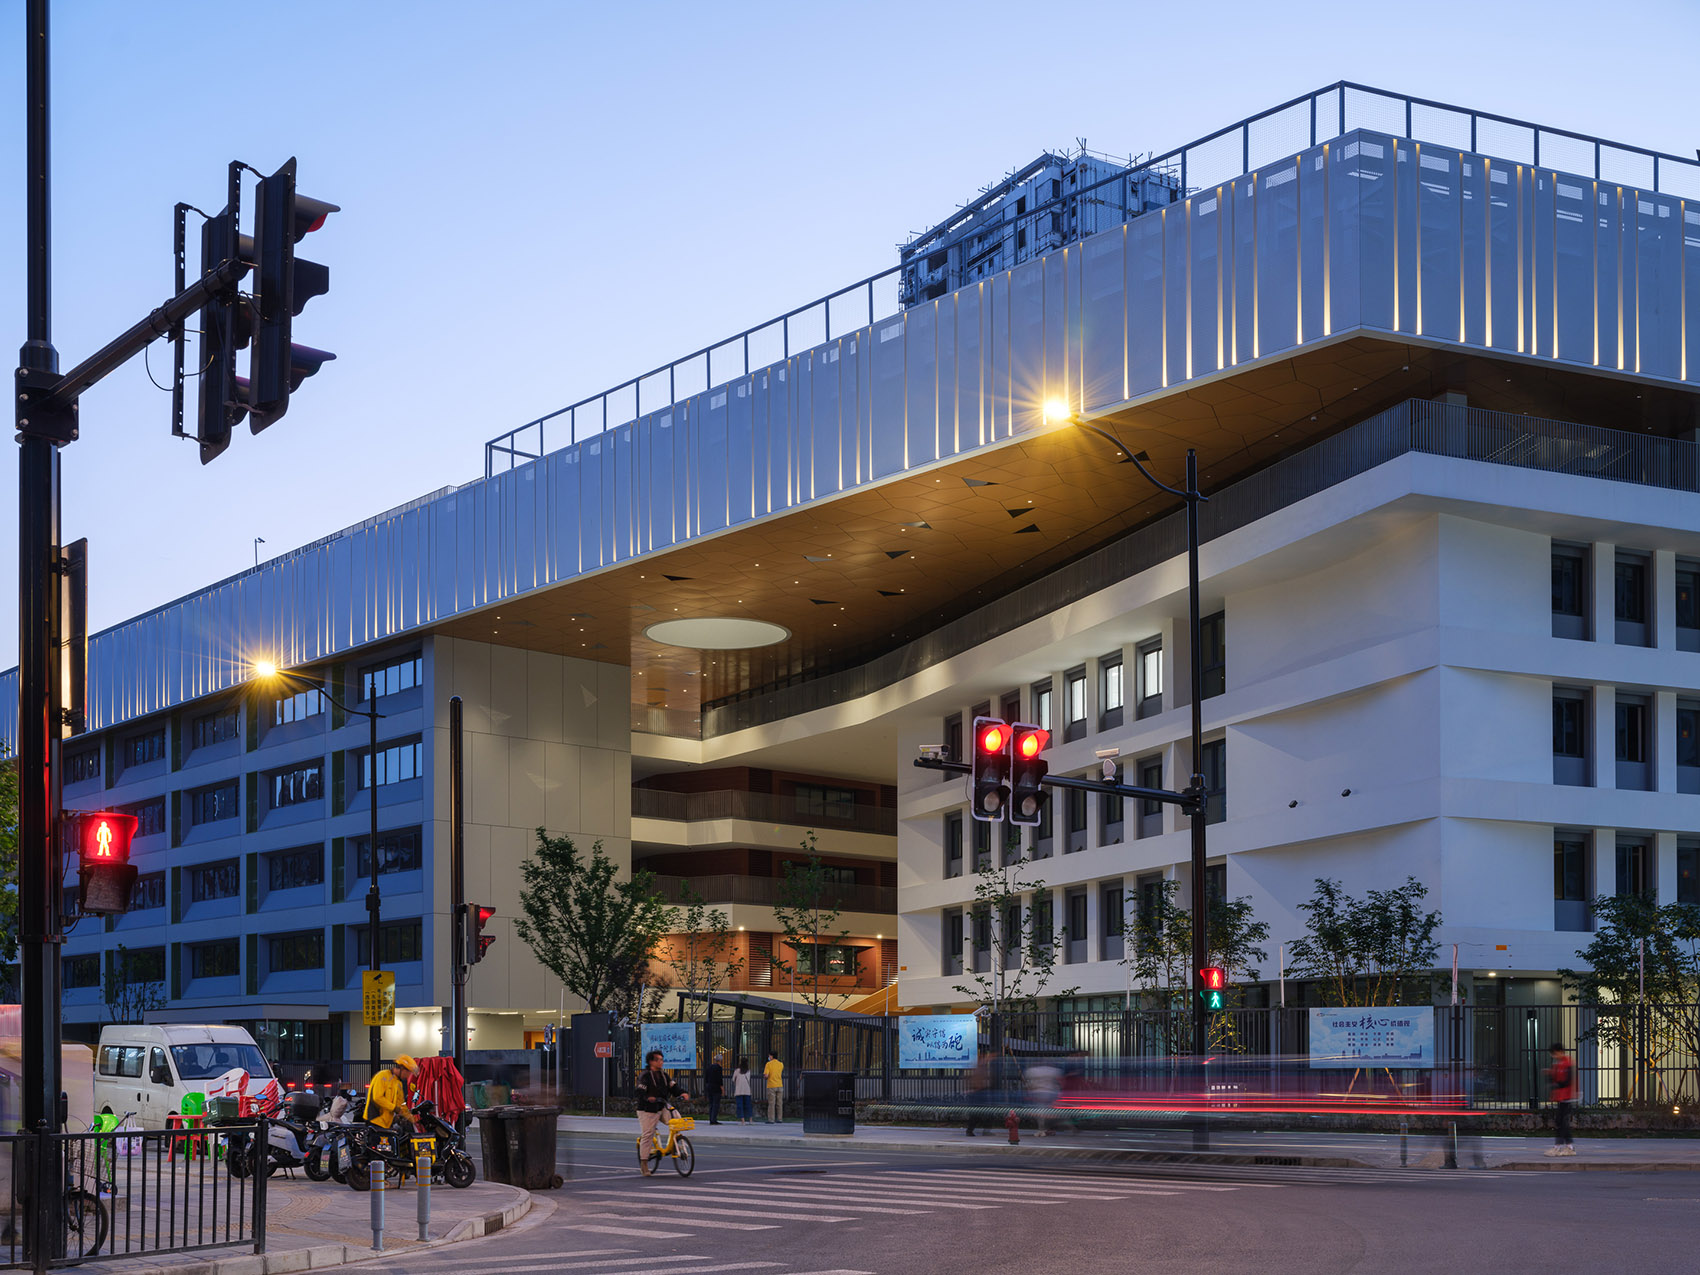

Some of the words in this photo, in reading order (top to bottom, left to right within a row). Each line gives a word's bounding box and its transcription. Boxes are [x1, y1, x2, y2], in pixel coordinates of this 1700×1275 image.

[1332, 1014, 1410, 1029] 社会主义核心价值观
[911, 1026, 946, 1044] 诚实守信
